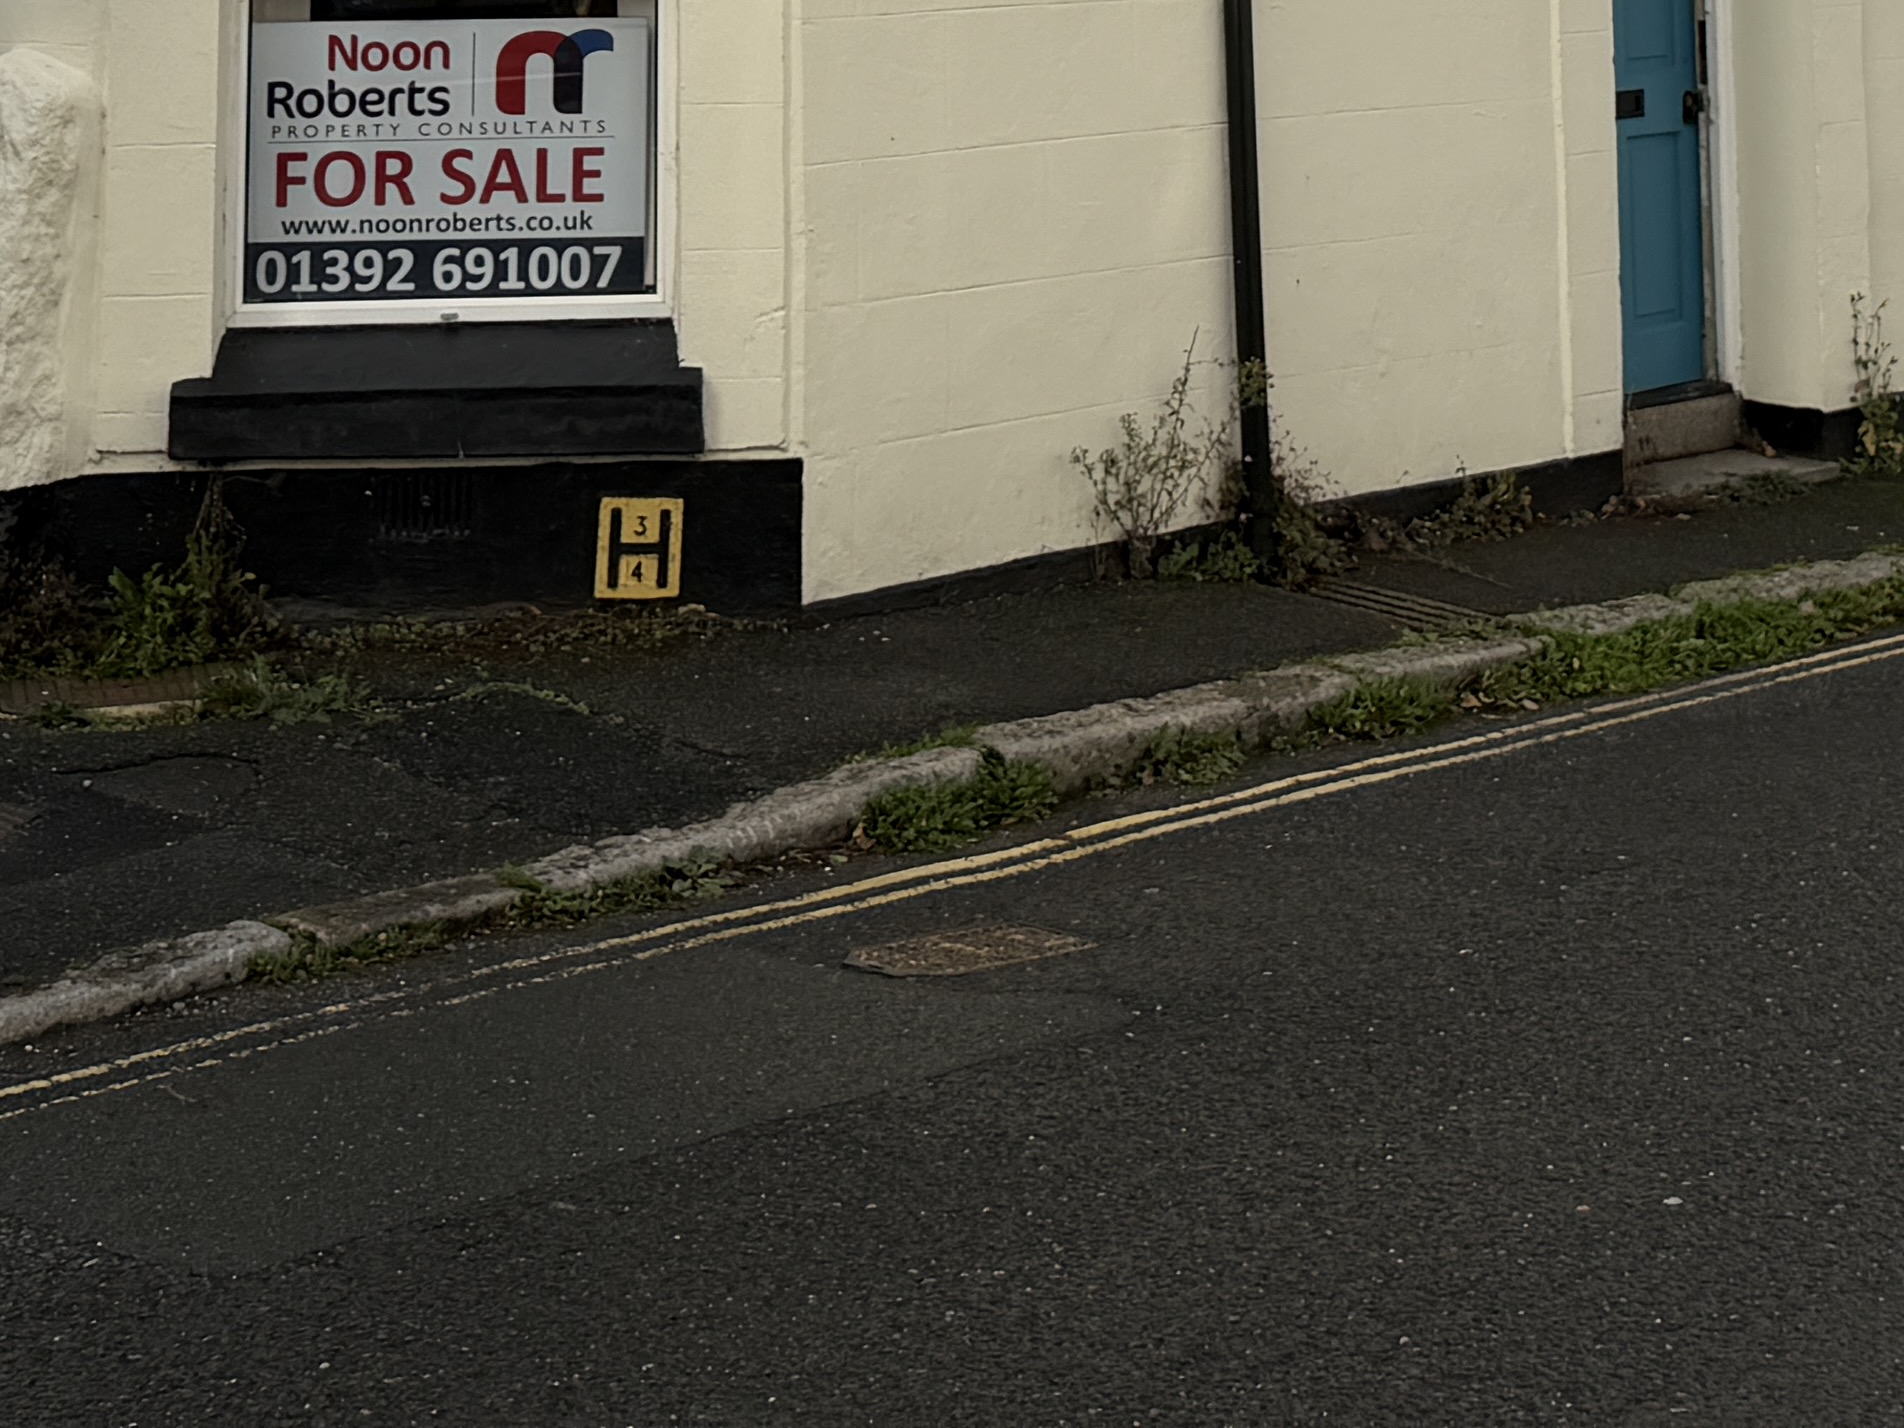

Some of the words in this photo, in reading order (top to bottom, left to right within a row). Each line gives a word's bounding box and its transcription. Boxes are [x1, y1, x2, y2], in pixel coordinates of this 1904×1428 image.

[328, 34, 451, 72] Noon
[266, 79, 451, 119] Roberts
[271, 122, 401, 139] PROPERTY
[418, 119, 607, 137] CONSULTANTS
[275, 150, 415, 208] FOR
[440, 147, 605, 205] SALE
[281, 210, 593, 236] www.noonroberts.co.uk
[255, 248, 415, 293] 01392
[433, 245, 623, 291] 691007
[633, 515, 648, 536] 3
[607, 507, 671, 589] H
[631, 560, 644, 583] 4
